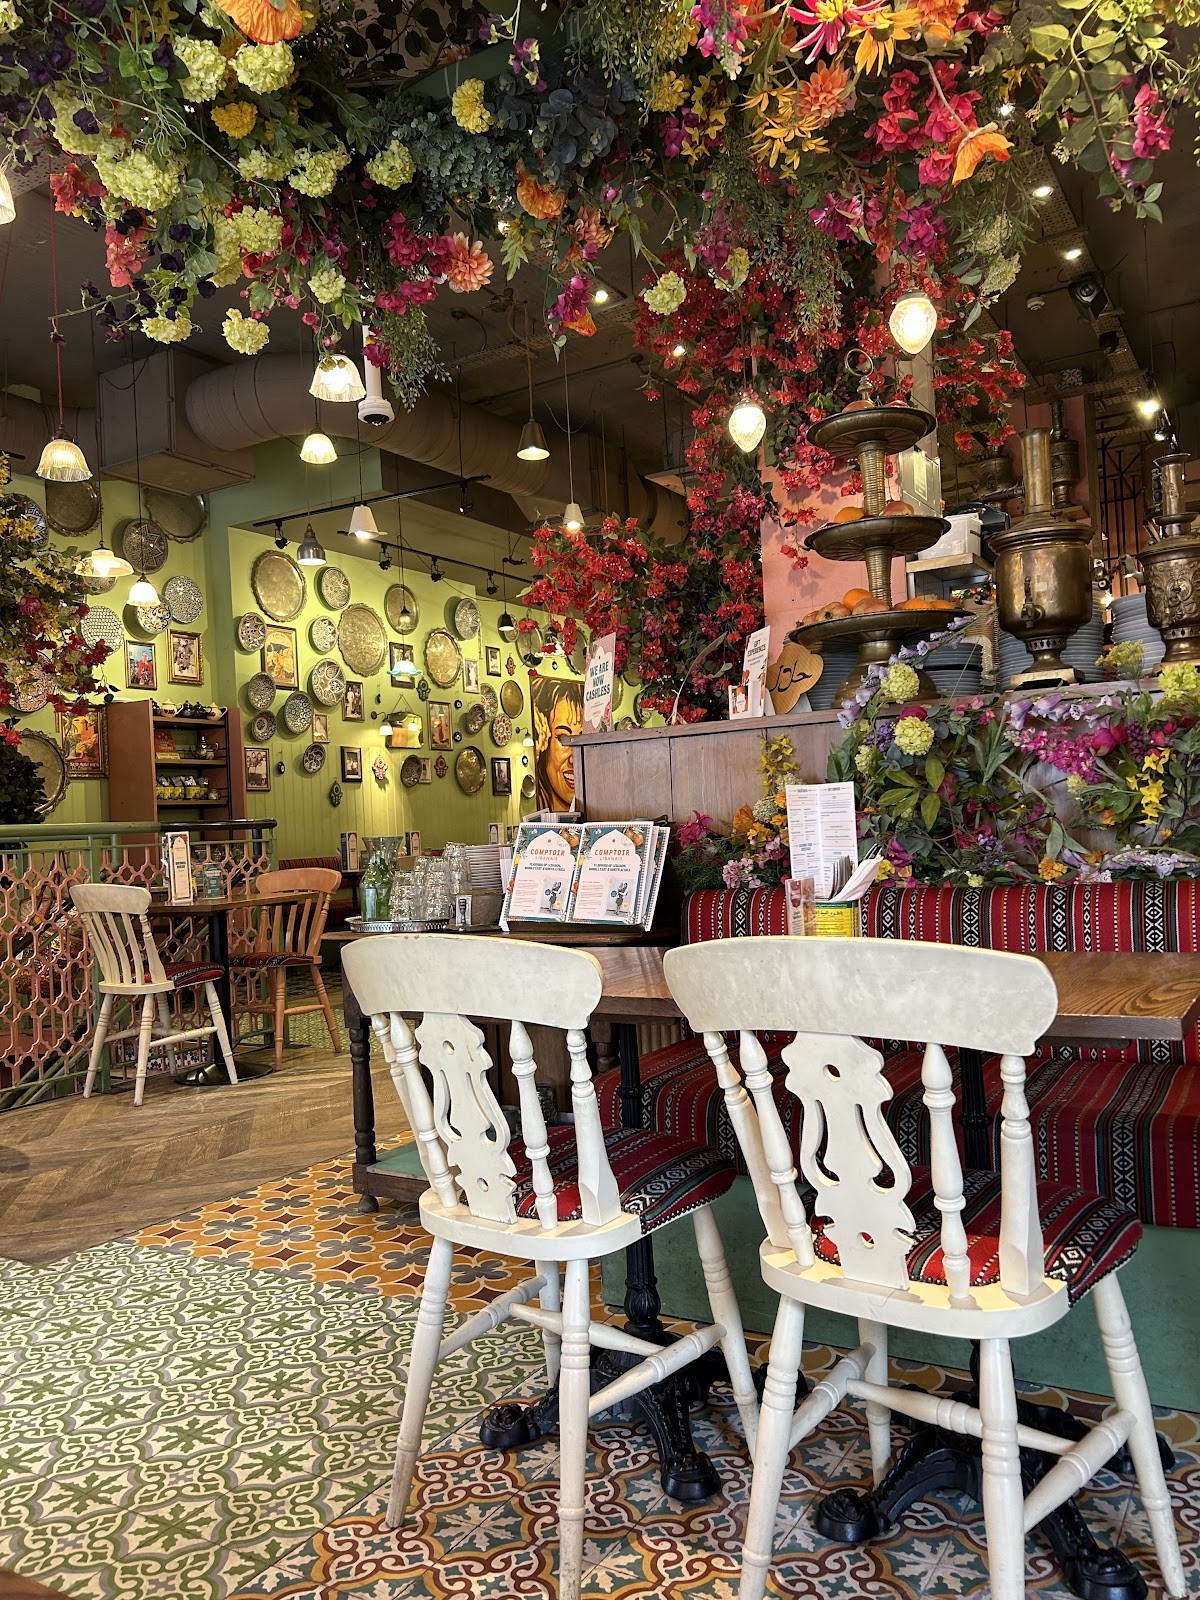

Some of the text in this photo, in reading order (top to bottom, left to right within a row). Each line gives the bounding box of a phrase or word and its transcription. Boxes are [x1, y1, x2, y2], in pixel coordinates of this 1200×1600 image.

[590, 661, 609, 678] WE ARE
[592, 675, 604, 688] NOW
[586, 684, 610, 702] CASHLESS
[530, 848, 565, 856] COMPTOIR
